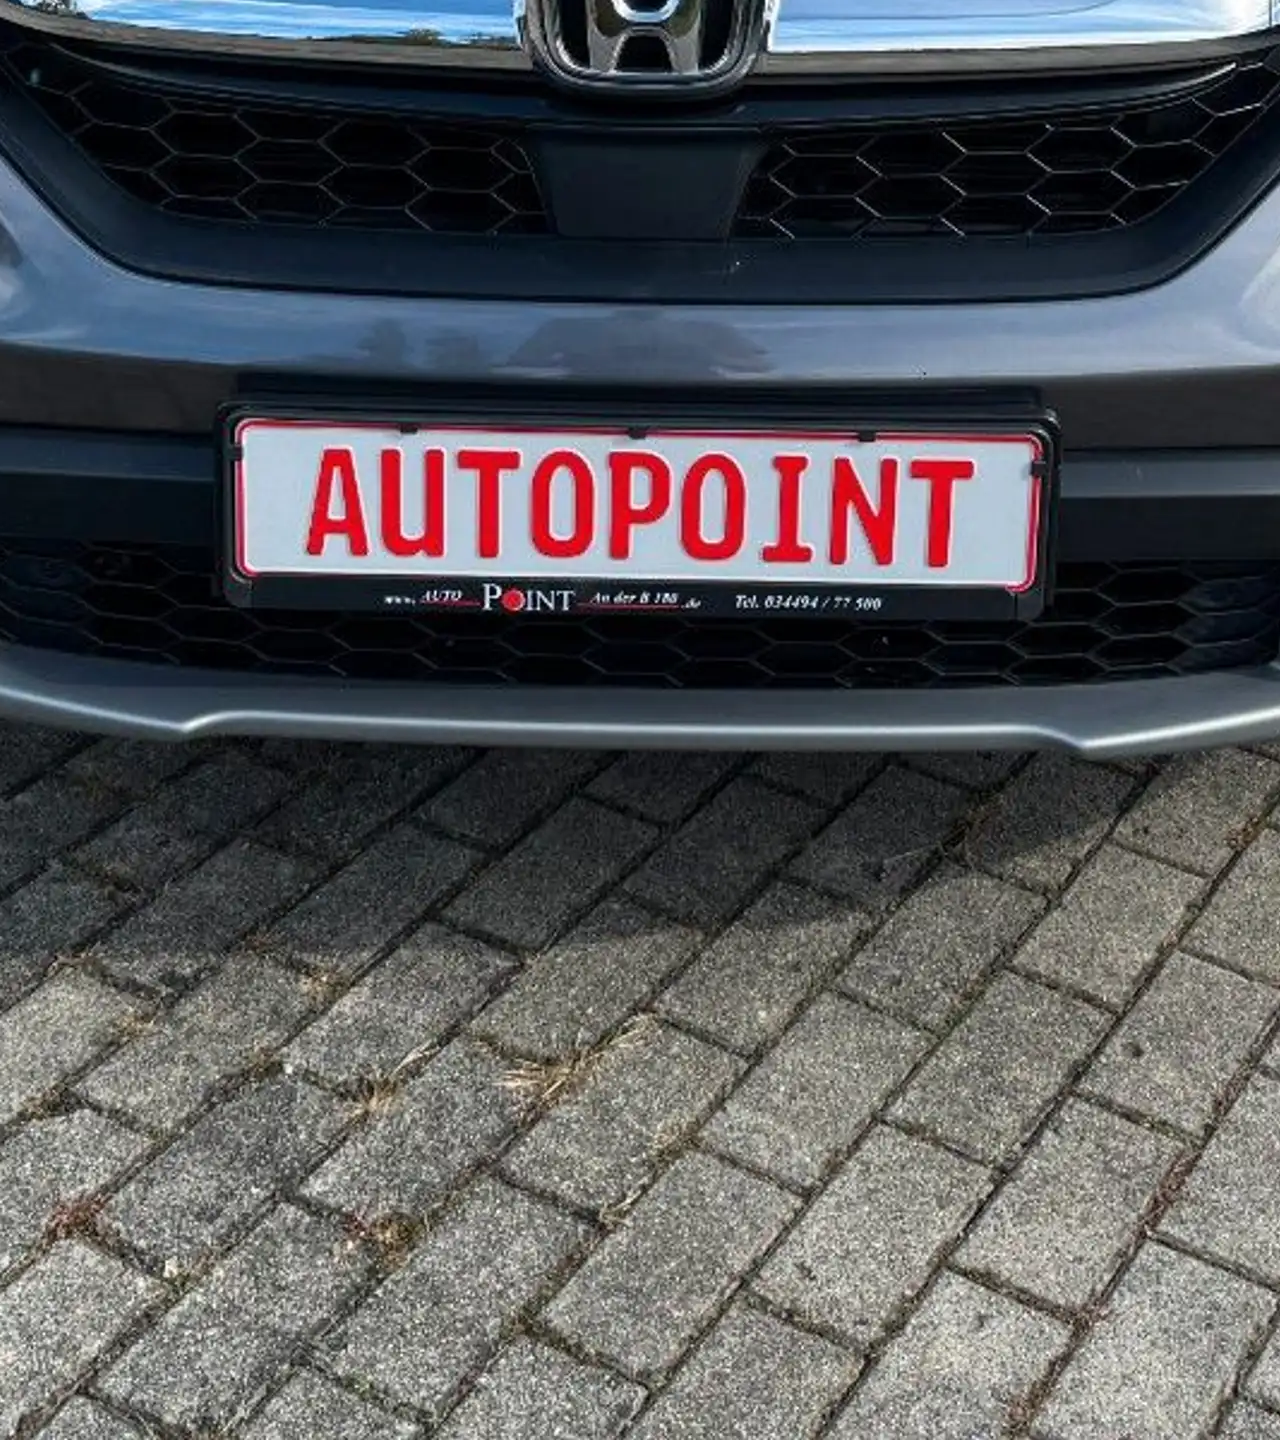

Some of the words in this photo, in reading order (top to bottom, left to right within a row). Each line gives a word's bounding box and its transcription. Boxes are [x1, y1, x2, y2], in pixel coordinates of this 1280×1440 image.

[306, 447, 975, 569] AUTOPOINT
[422, 588, 465, 602] AUTO
[481, 582, 576, 613] POINT
[735, 594, 760, 609] Tel.
